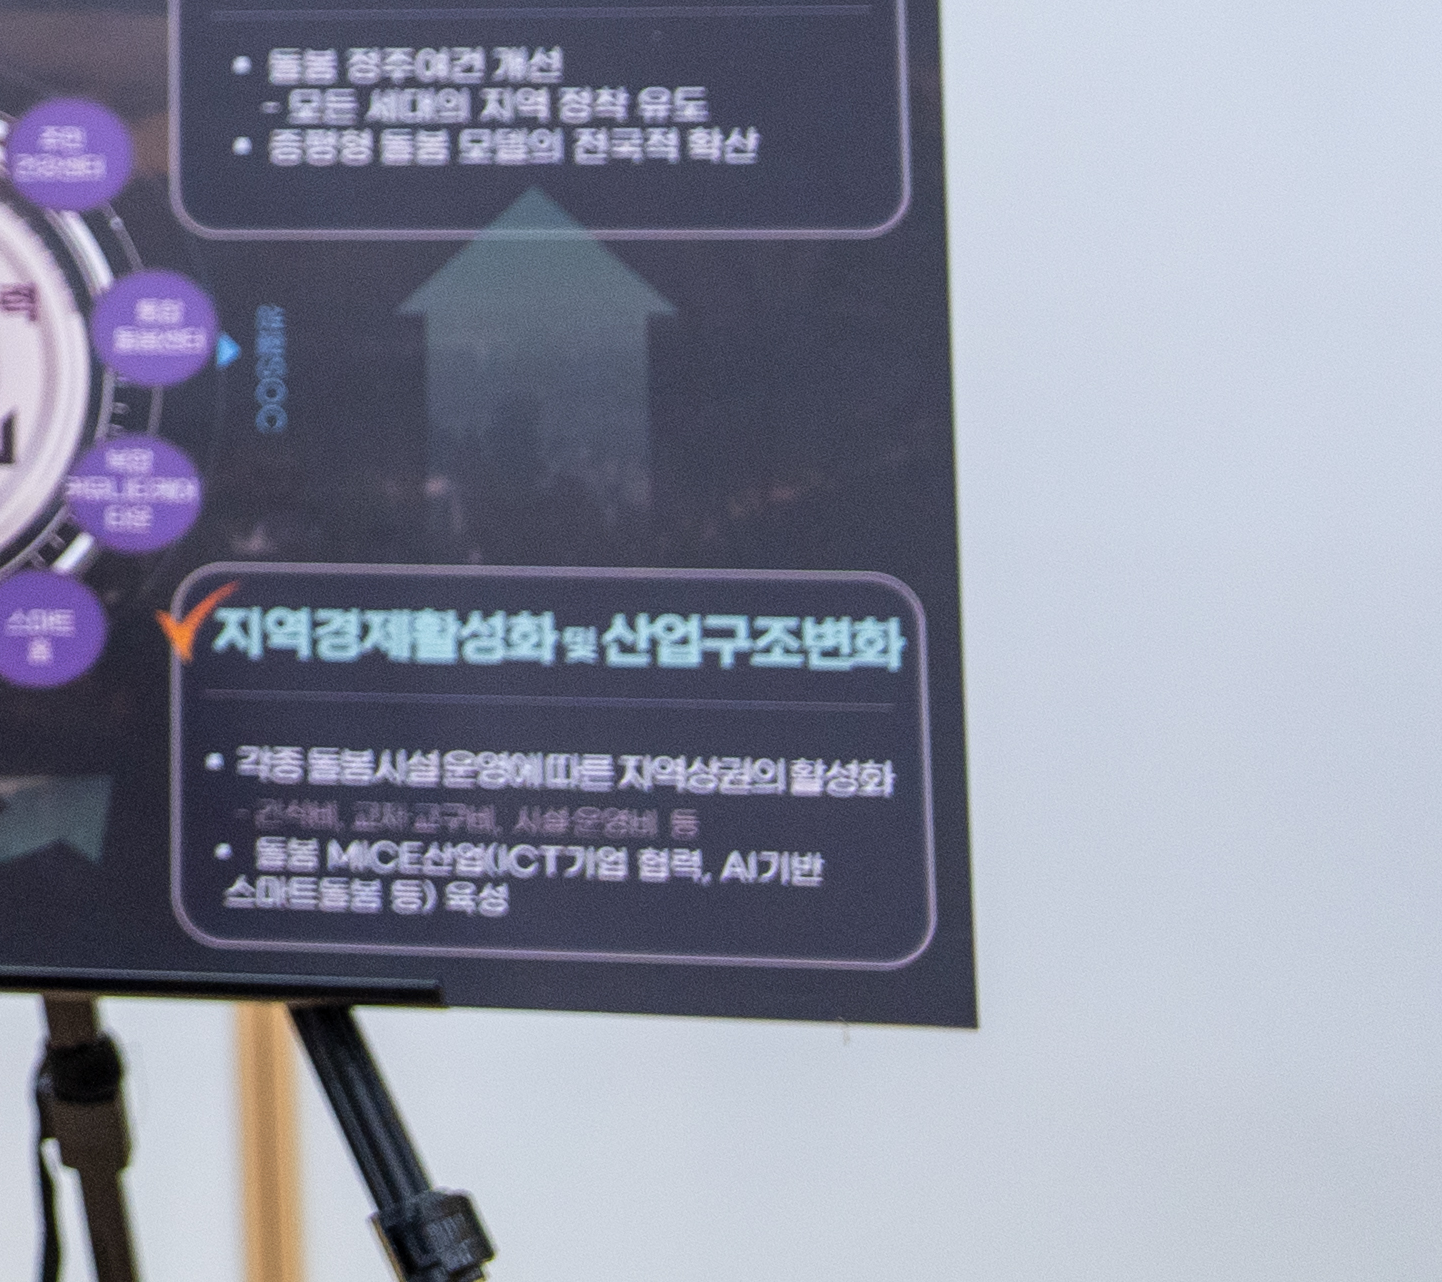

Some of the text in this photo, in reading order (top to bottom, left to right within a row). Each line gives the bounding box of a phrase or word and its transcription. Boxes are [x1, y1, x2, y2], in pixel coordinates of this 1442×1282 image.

[268, 46, 565, 86] 돌봄 정주여건 개선
[287, 86, 710, 125] 모든 세대의 지역 정착 유도
[268, 127, 761, 167] 증평형 돌봄 모델의 전국적 확산
[601, 613, 905, 673] 산업구조변화
[254, 837, 319, 873] 돌봄
[719, 848, 826, 888] AI기반
[223, 876, 510, 918] 스마트돌봄 등) 육성
